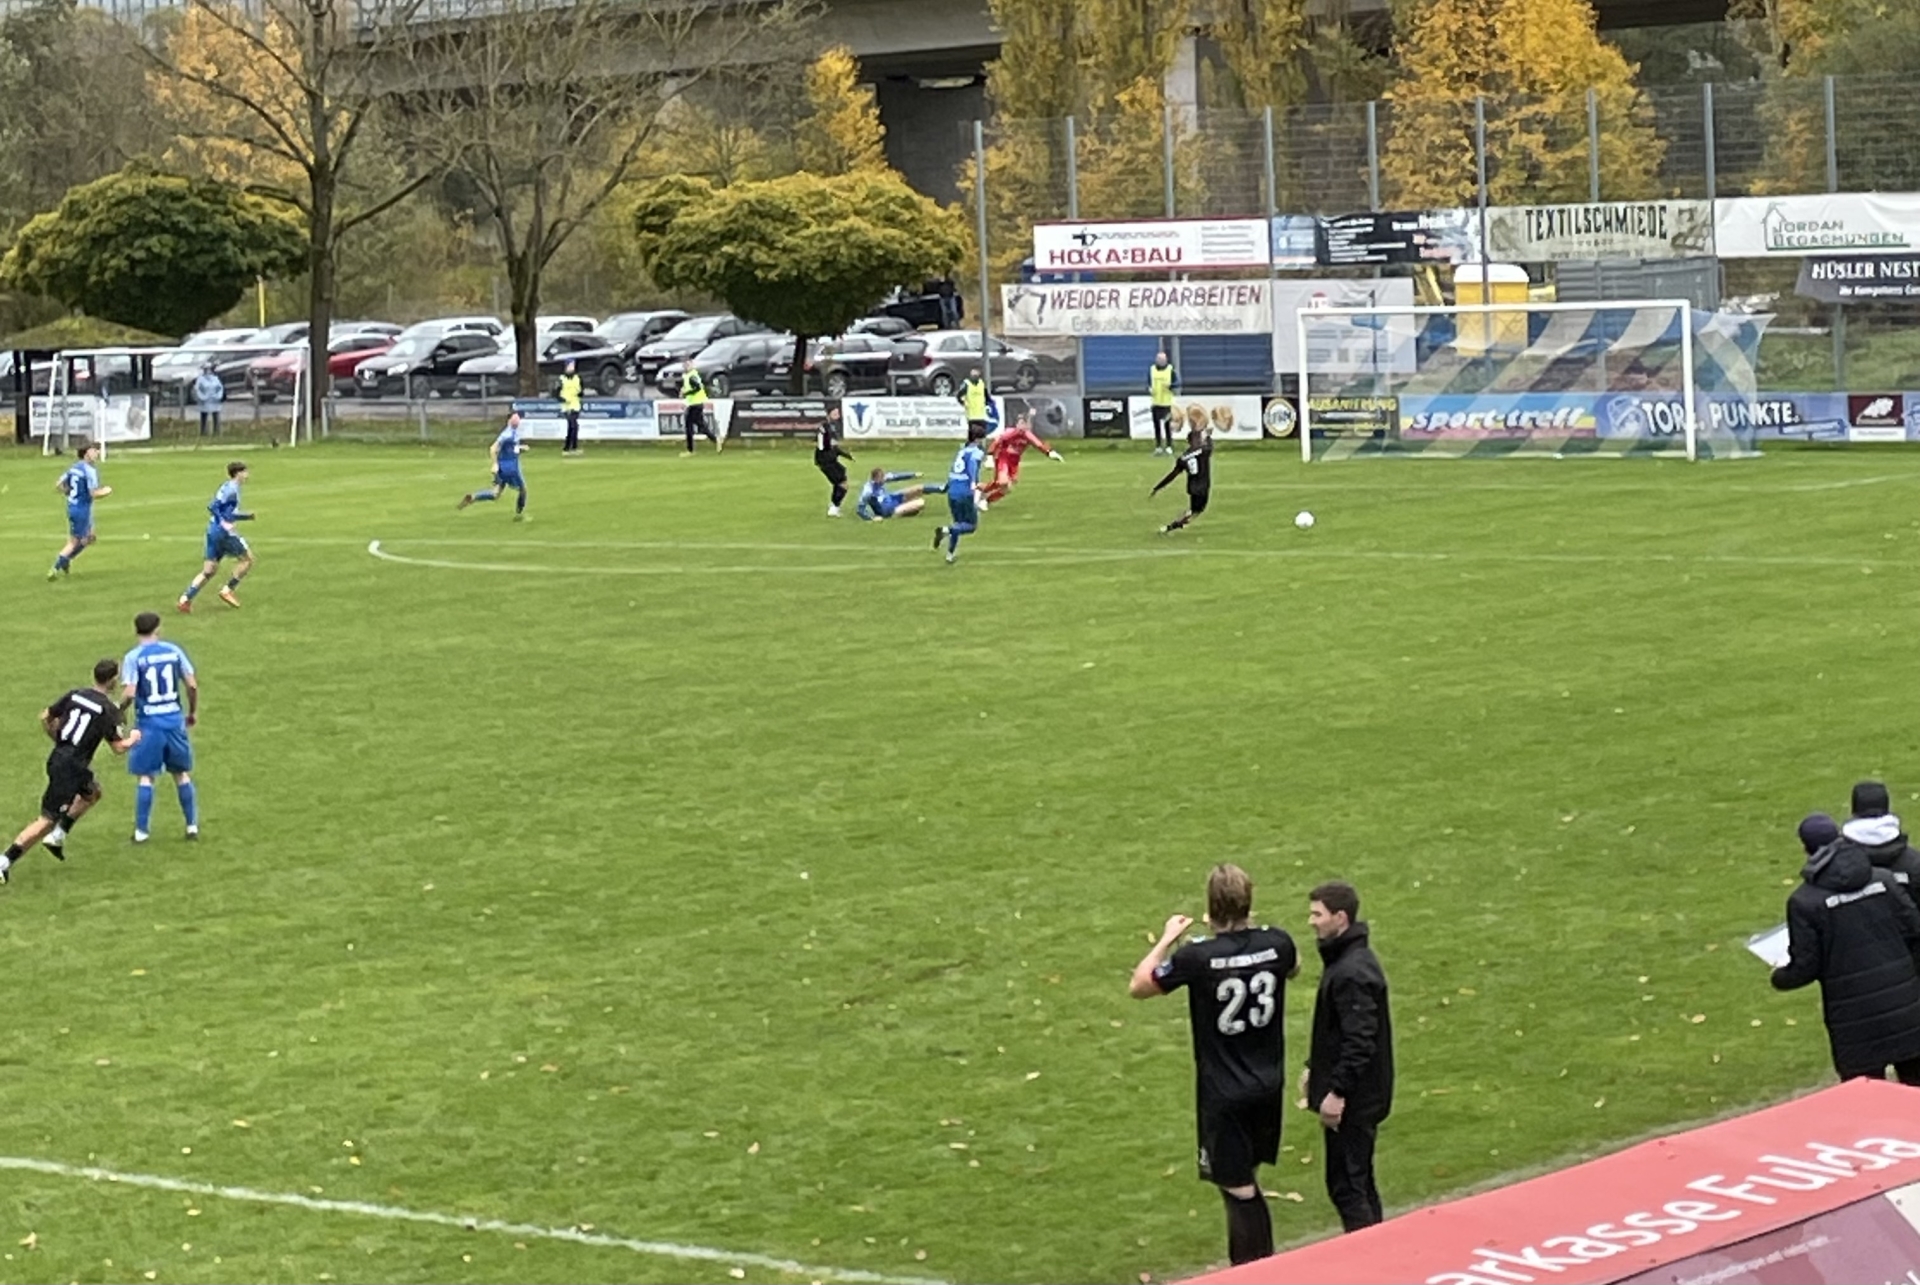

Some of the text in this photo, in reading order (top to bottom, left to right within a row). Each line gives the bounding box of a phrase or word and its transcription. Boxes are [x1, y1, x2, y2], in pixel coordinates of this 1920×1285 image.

[1525, 204, 1668, 244] TEXTILSCHMIEDE
[1772, 220, 1844, 235] JORDAN
[1811, 260, 1920, 280] HÜSLER NEST
[1050, 285, 1262, 309] WEIDER ERDARBEITEN
[1708, 401, 1801, 429] PUNKTE.
[144, 663, 178, 703] 11
[60, 708, 92, 745] 11
[1216, 970, 1278, 1036] 23
[1425, 1137, 1920, 1285] arkasse Fulda
